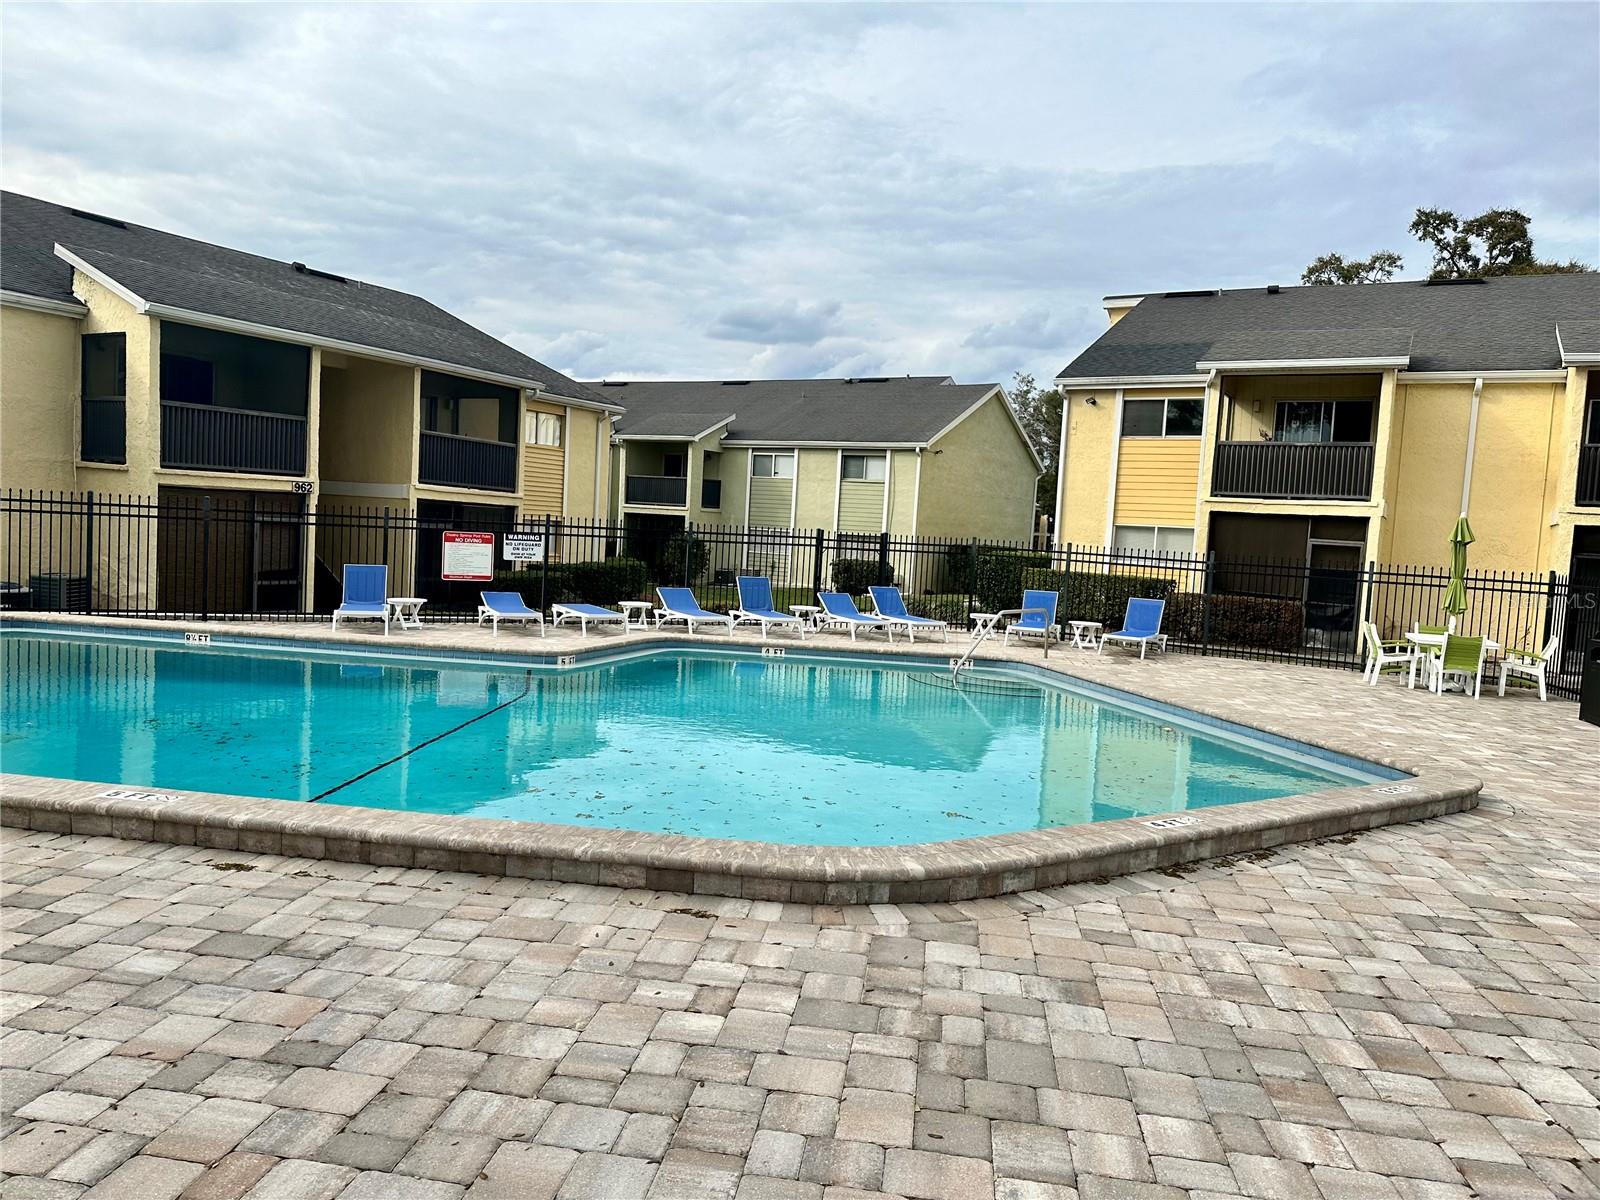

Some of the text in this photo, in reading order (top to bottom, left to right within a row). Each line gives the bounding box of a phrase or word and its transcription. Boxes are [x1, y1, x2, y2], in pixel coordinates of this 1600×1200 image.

[294, 482, 313, 493] 962
[124, 792, 157, 800] FT
[1162, 819, 1187, 827] FT
